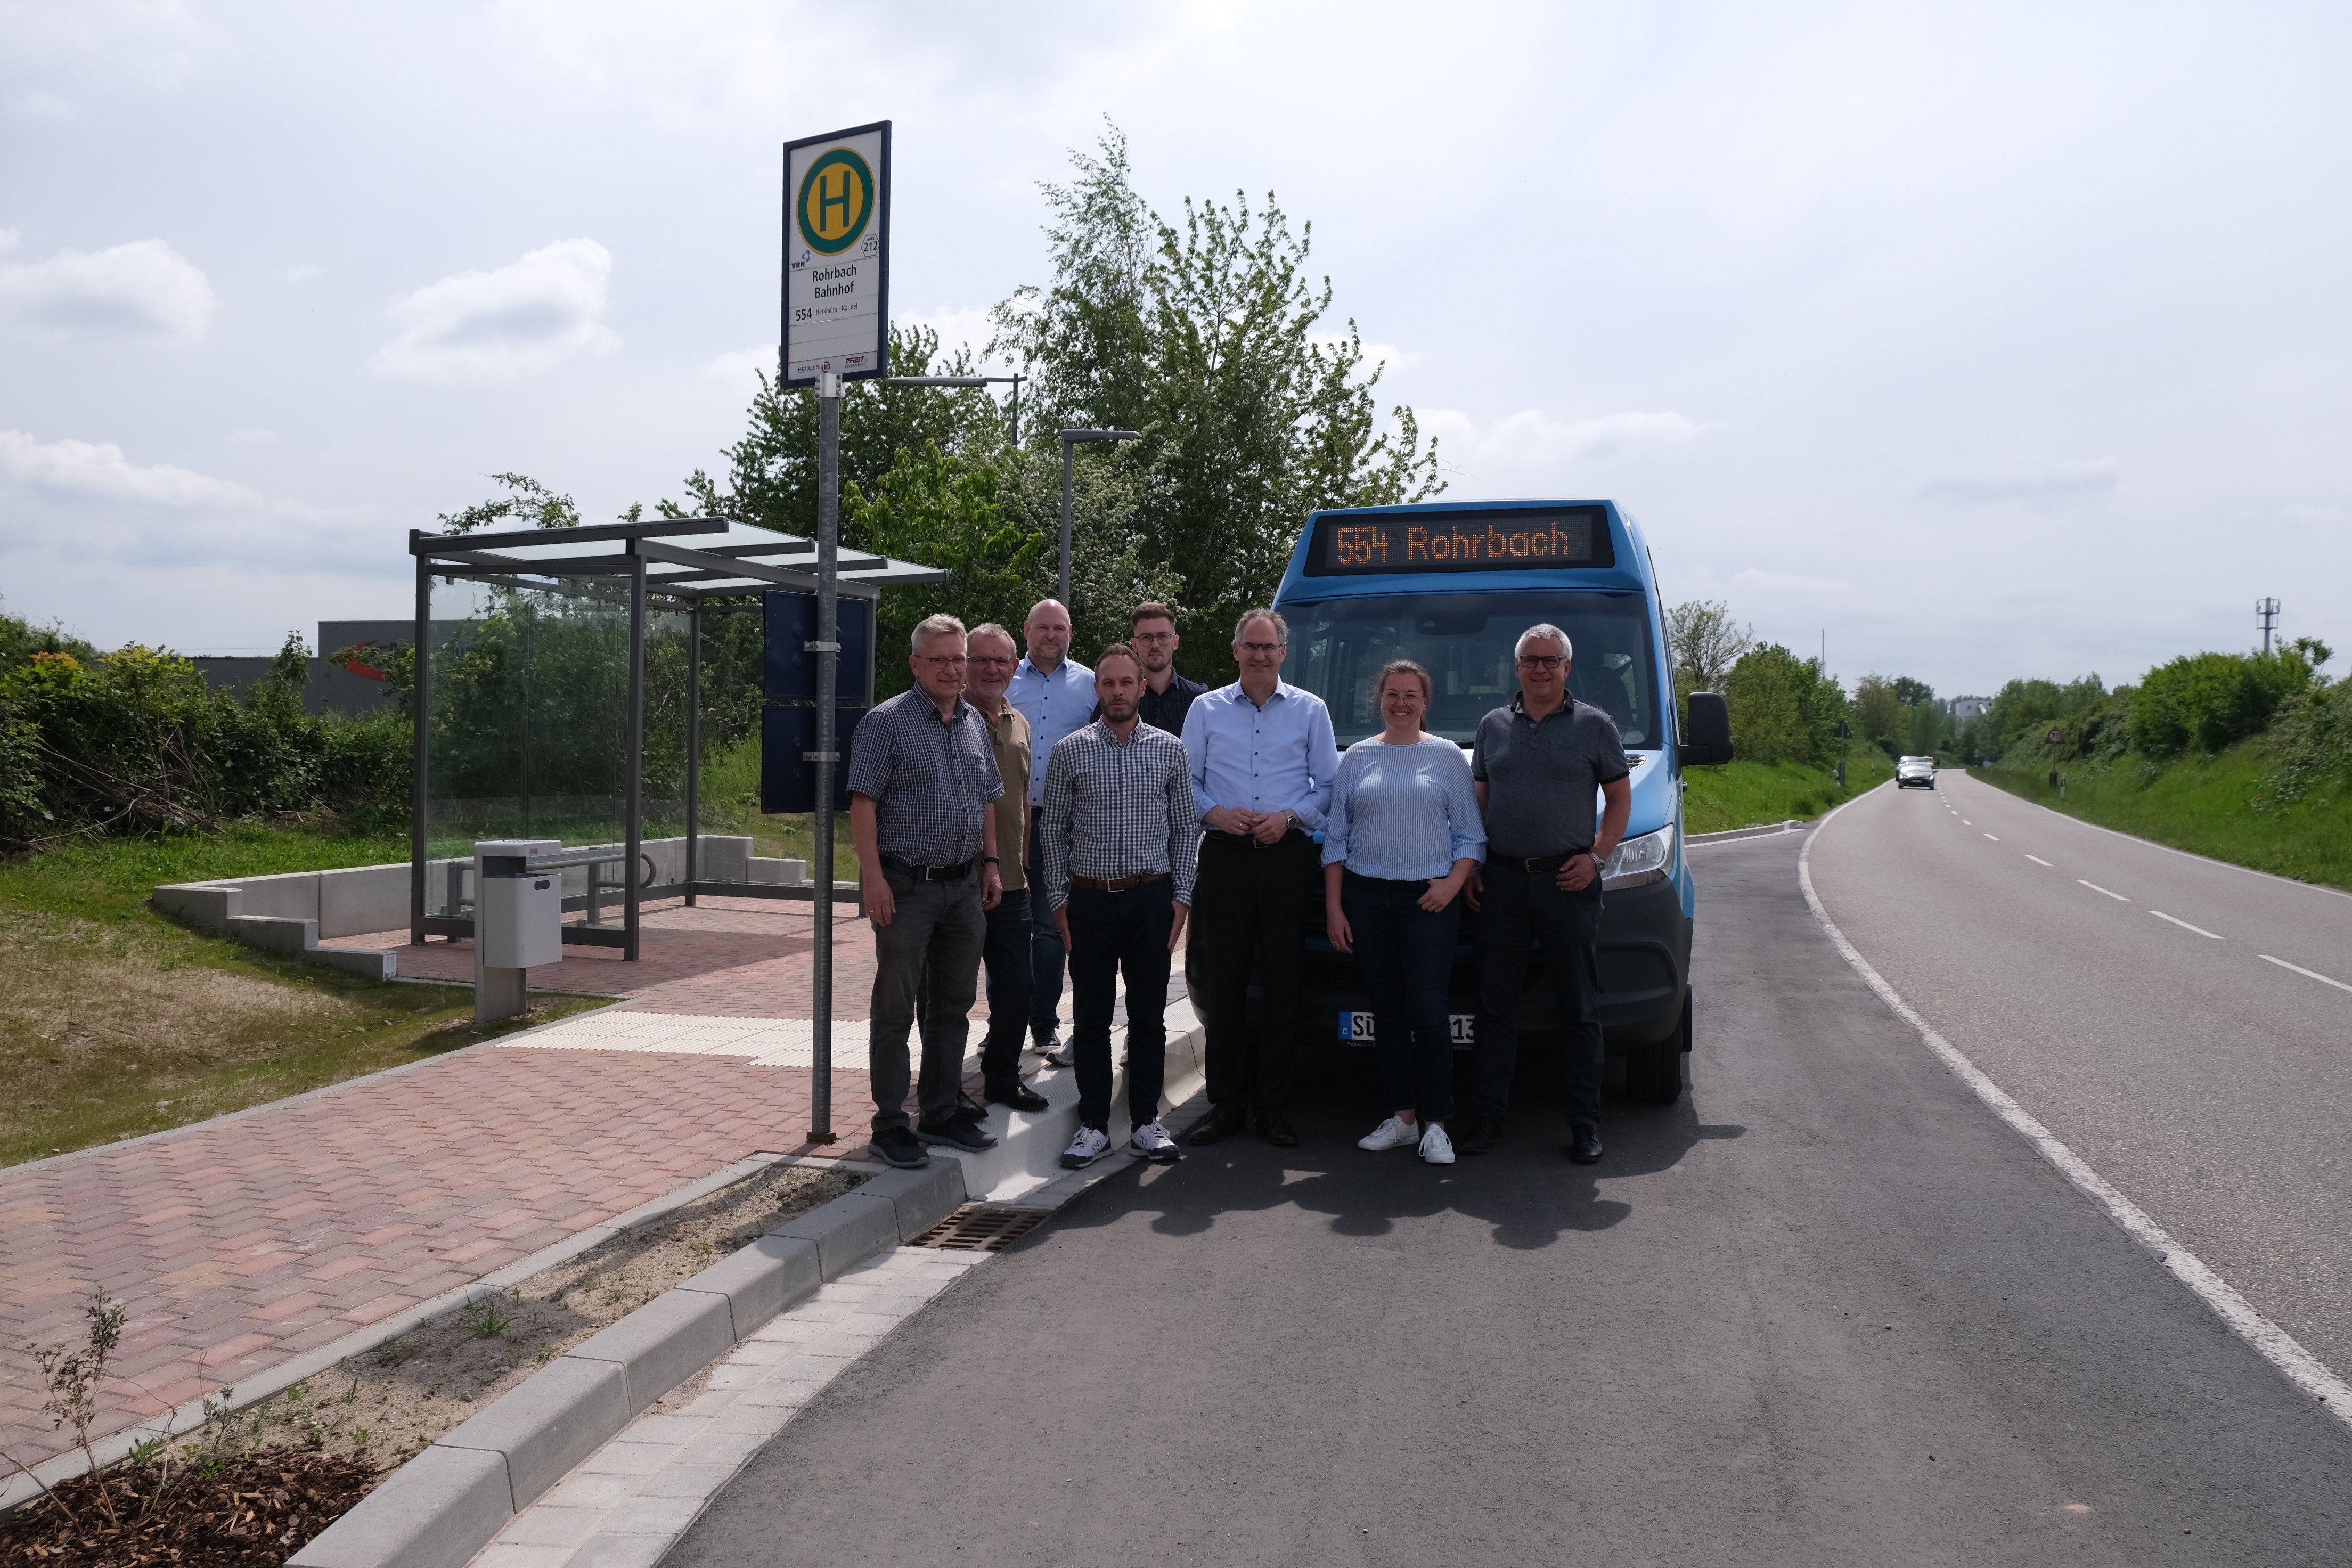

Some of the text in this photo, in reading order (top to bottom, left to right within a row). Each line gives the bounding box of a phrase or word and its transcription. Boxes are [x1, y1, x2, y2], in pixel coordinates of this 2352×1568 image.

[819, 170, 850, 232] H
[864, 241, 878, 251] 212
[813, 264, 856, 282] Rohrbach
[815, 281, 854, 298] Bahnhof
[796, 308, 812, 321] 554
[815, 306, 837, 315] Herxheim
[842, 303, 858, 311] Kandel
[1338, 522, 1569, 564] 554 Rohrbach
